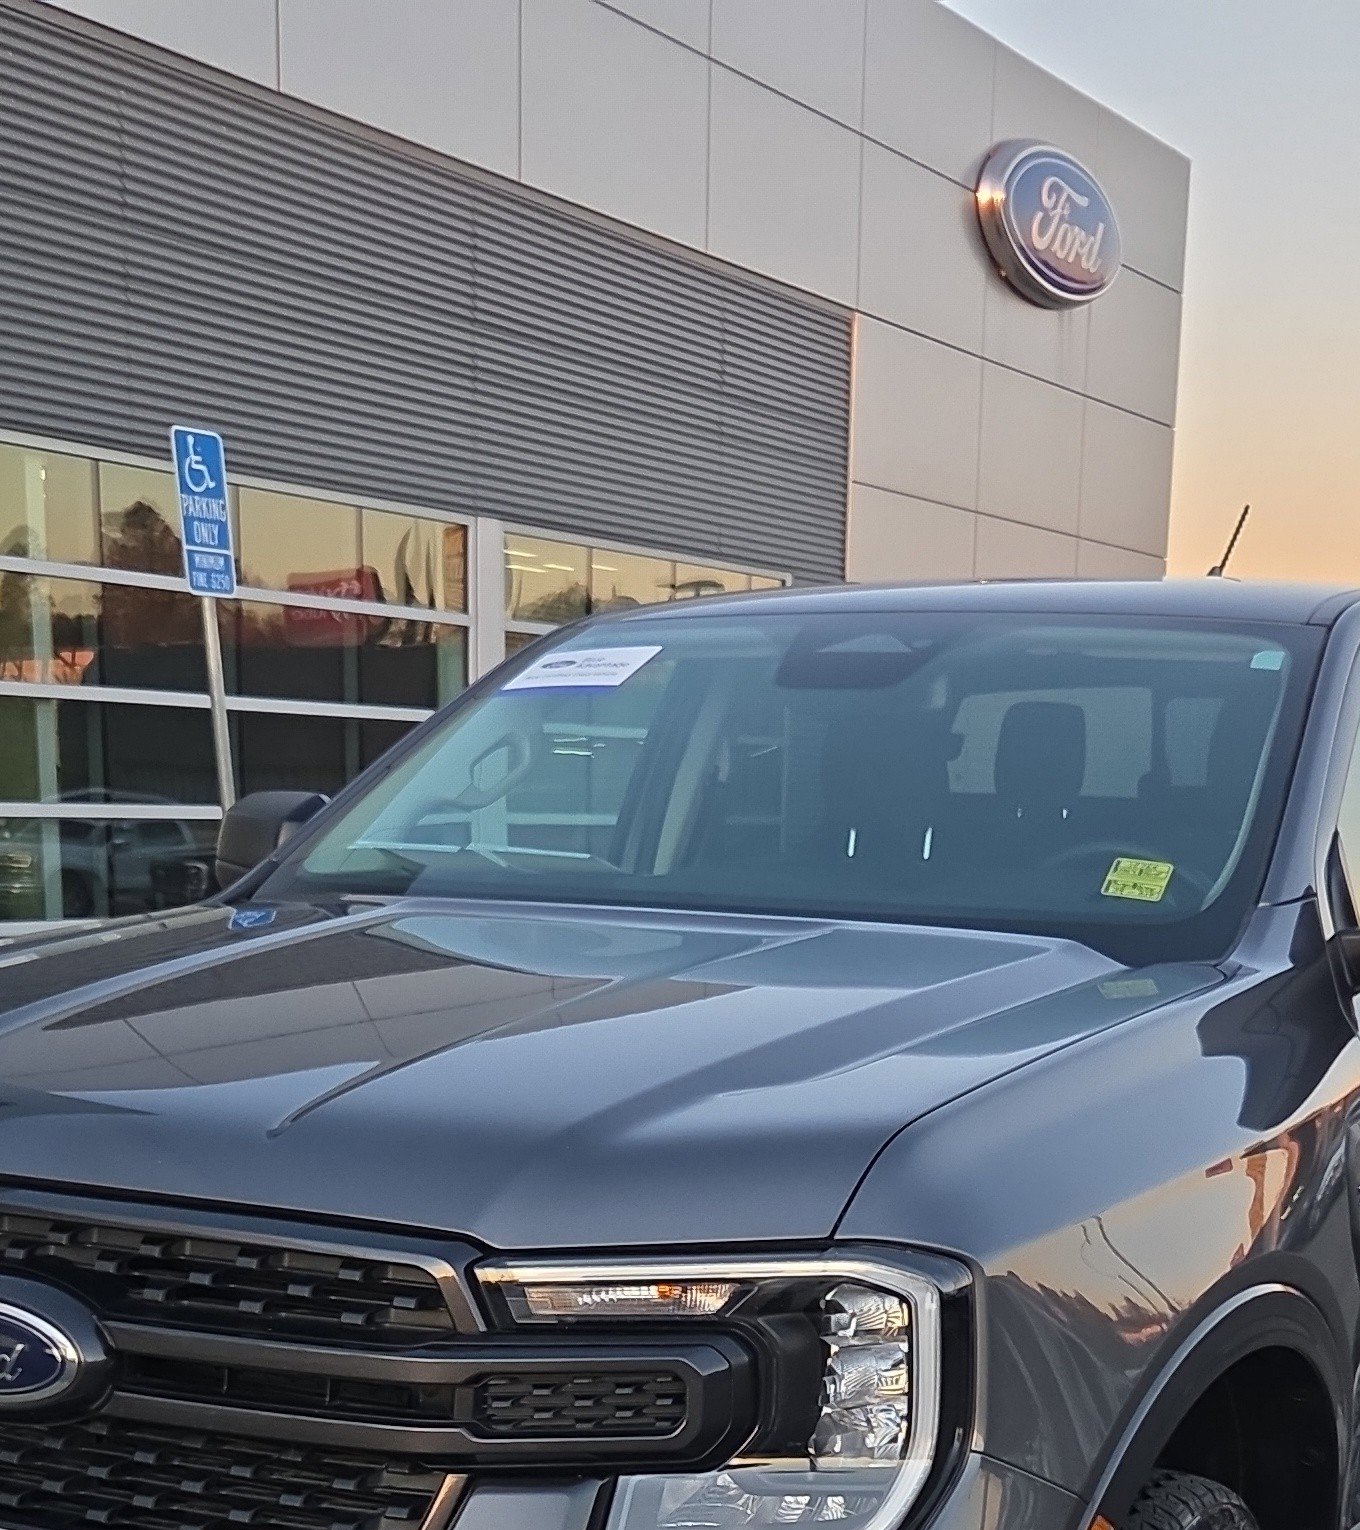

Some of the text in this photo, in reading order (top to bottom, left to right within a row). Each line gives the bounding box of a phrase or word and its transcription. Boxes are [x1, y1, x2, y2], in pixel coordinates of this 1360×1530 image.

[1030, 175, 1105, 274] Ford
[181, 493, 227, 522] PARKING
[193, 520, 219, 546] ONLY
[192, 571, 230, 591] FINE $250
